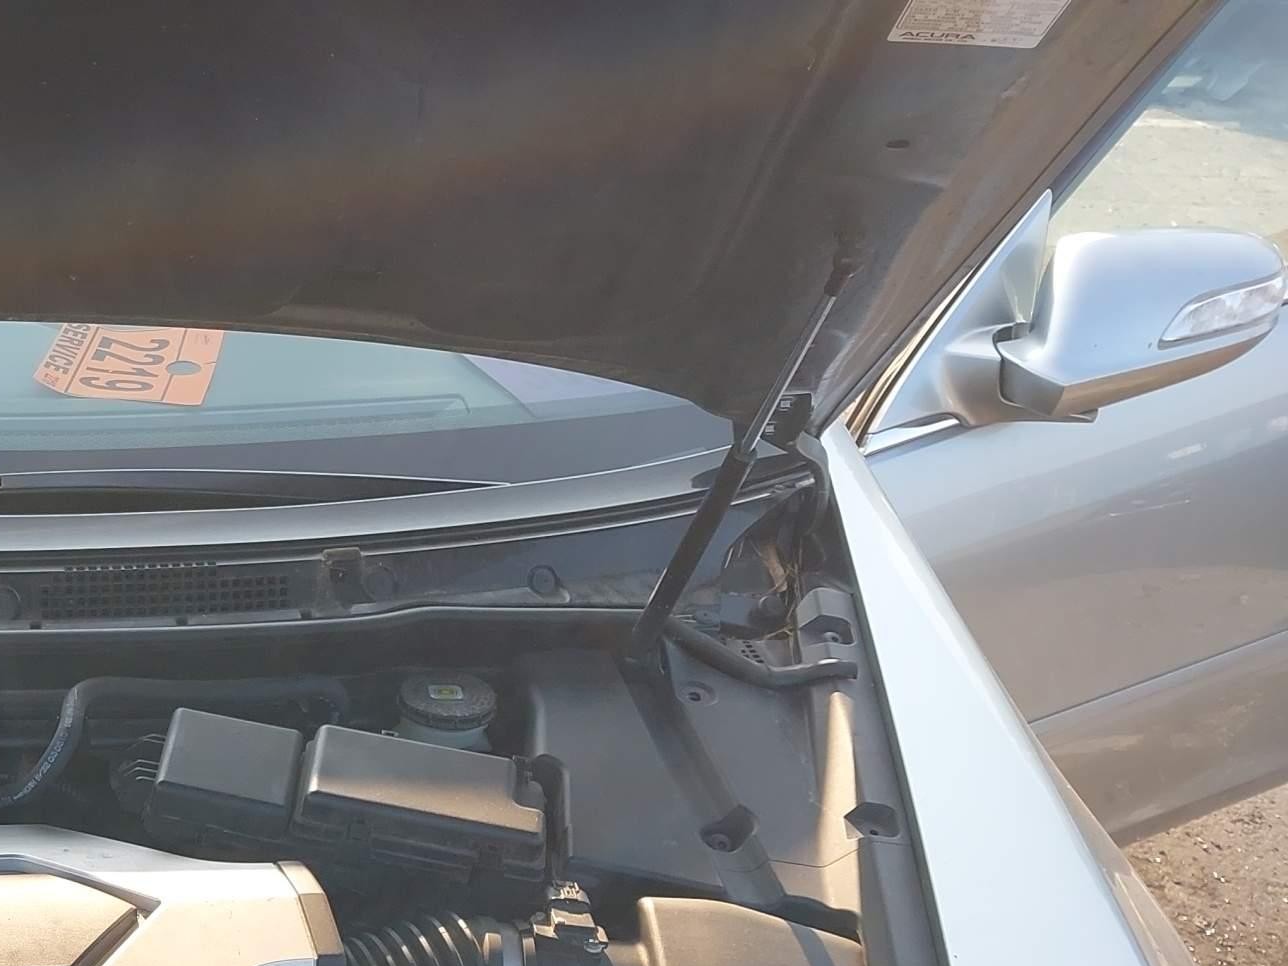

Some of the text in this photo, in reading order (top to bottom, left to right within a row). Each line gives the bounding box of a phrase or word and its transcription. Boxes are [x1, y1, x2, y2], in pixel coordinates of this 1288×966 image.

[899, 31, 976, 40] ACURA
[44, 323, 91, 375] SERVICE
[79, 336, 170, 392] 2219
